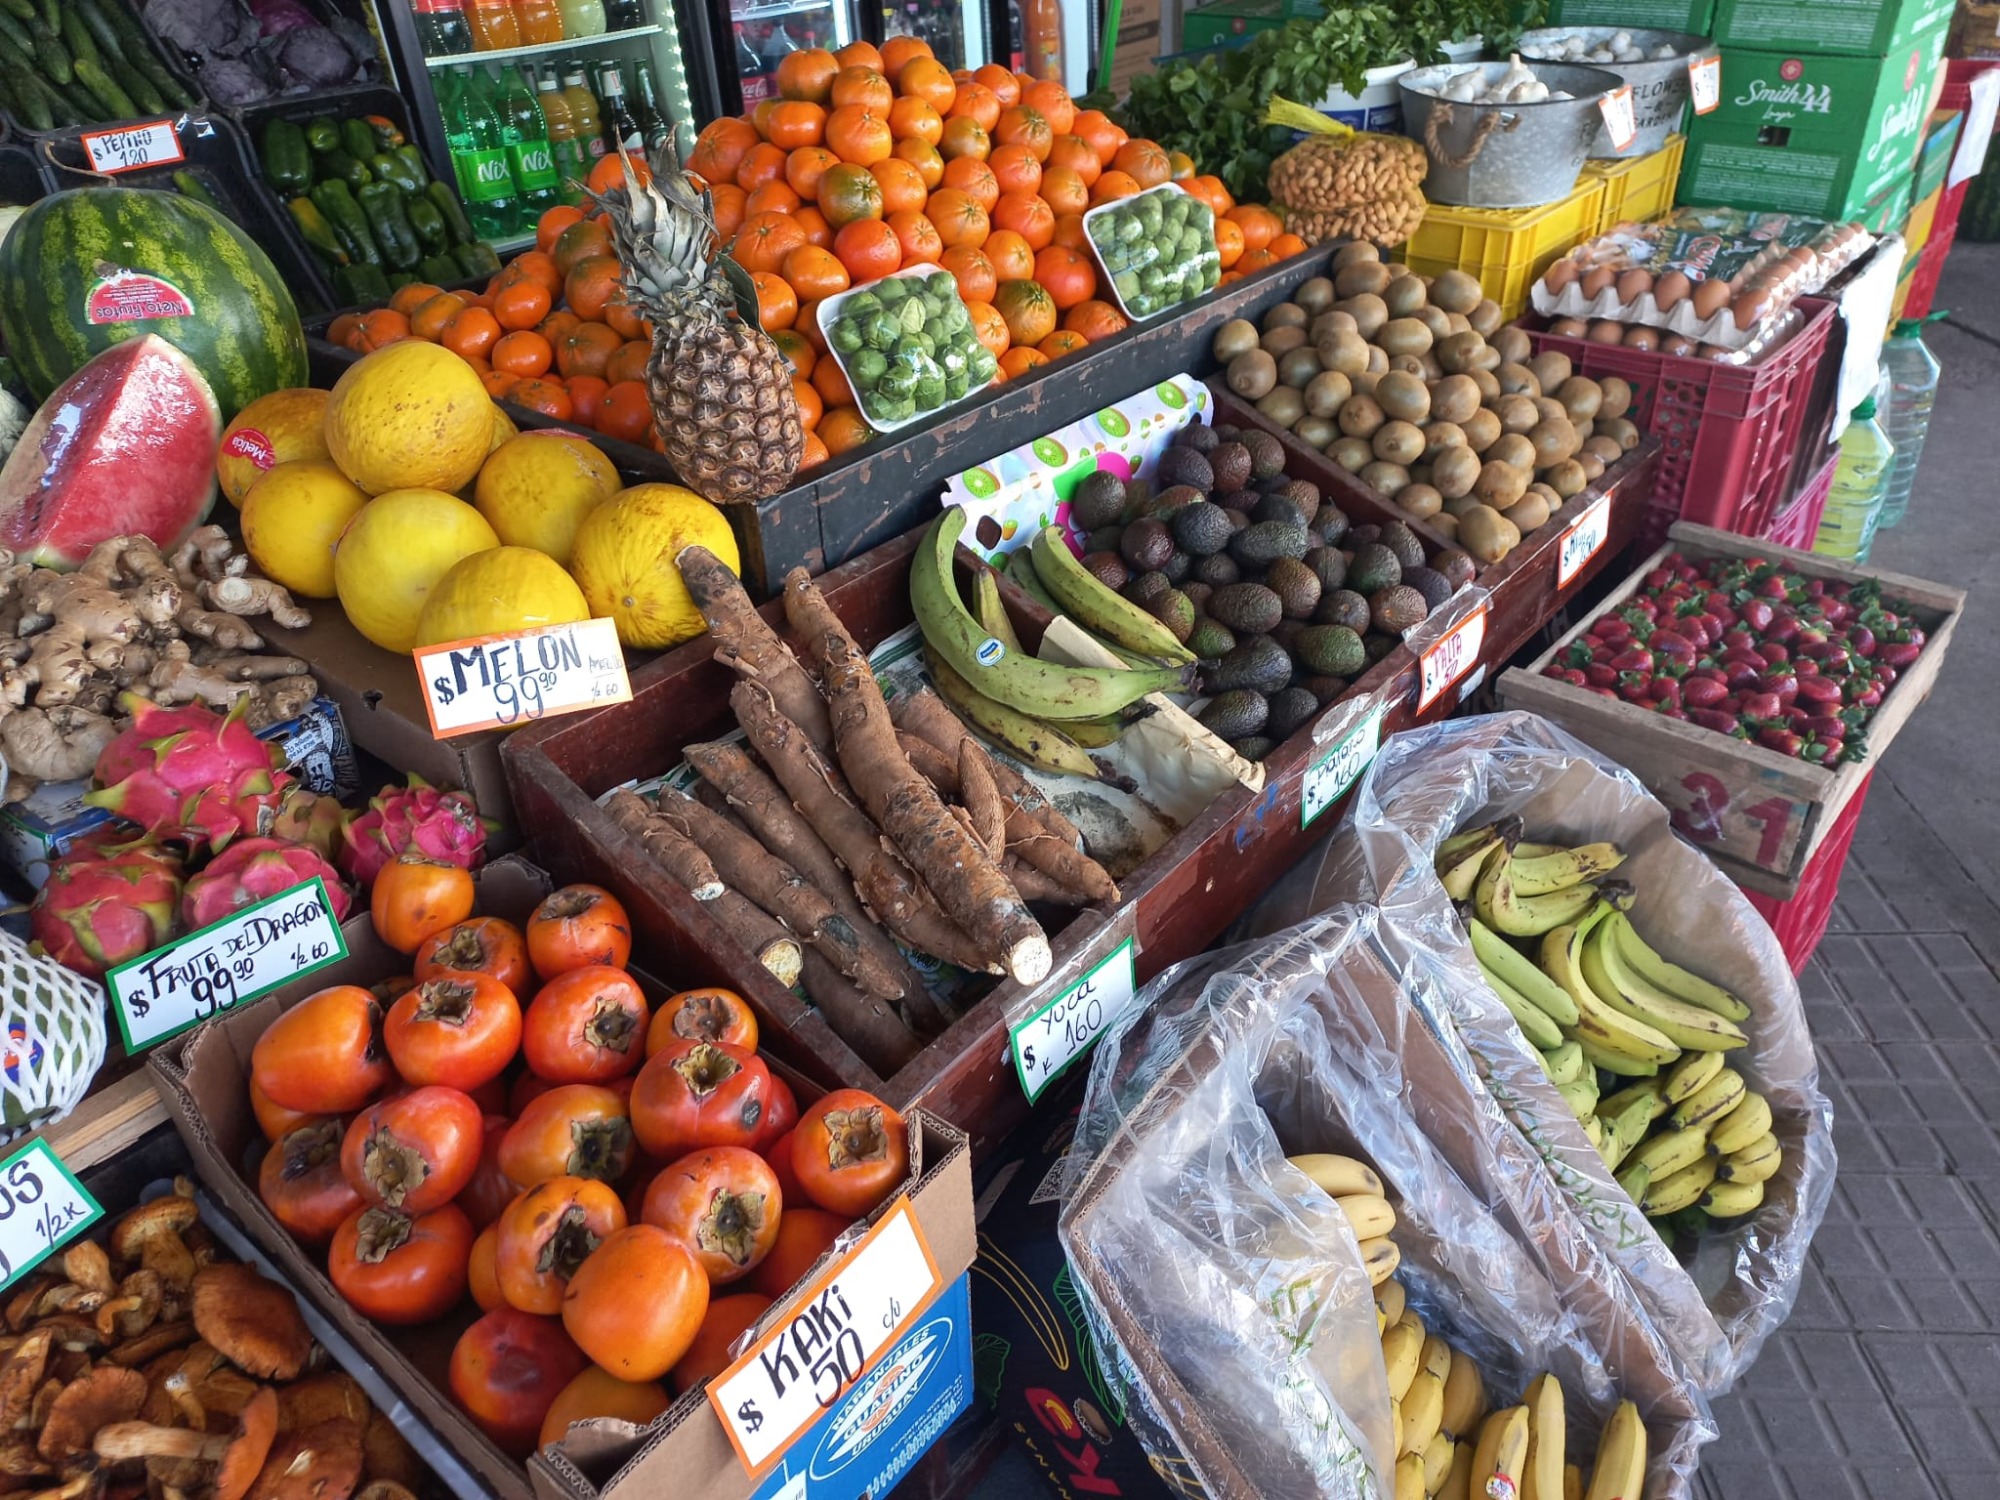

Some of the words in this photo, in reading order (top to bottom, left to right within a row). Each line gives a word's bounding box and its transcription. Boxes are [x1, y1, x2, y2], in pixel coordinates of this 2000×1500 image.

[1735, 79, 1800, 105] Smith
[1799, 83, 1831, 113] 44
[120, 147, 148, 167] 120
[478, 158, 511, 182] Nix
[523, 149, 554, 173] Nix
[96, 304, 142, 318] Frutas
[146, 300, 183, 315] Neto
[449, 629, 582, 695] MELON
[1430, 633, 1462, 678] PALTA
[434, 676, 455, 705] $
[1672, 772, 1792, 866] 31
[139, 948, 221, 1000] FRUTA
[222, 928, 255, 958] DEL
[242, 888, 328, 956] DRAGON
[312, 941, 329, 960] 60
[128, 989, 150, 1018] $
[1024, 1045, 1035, 1071] $
[1065, 999, 1102, 1055] 160
[738, 1398, 764, 1434] $
[809, 1327, 864, 1408] 50
[831, 1328, 930, 1430] NARANJALES
[843, 1353, 925, 1441] GUARINO
[851, 1380, 919, 1456] URUGUAY
